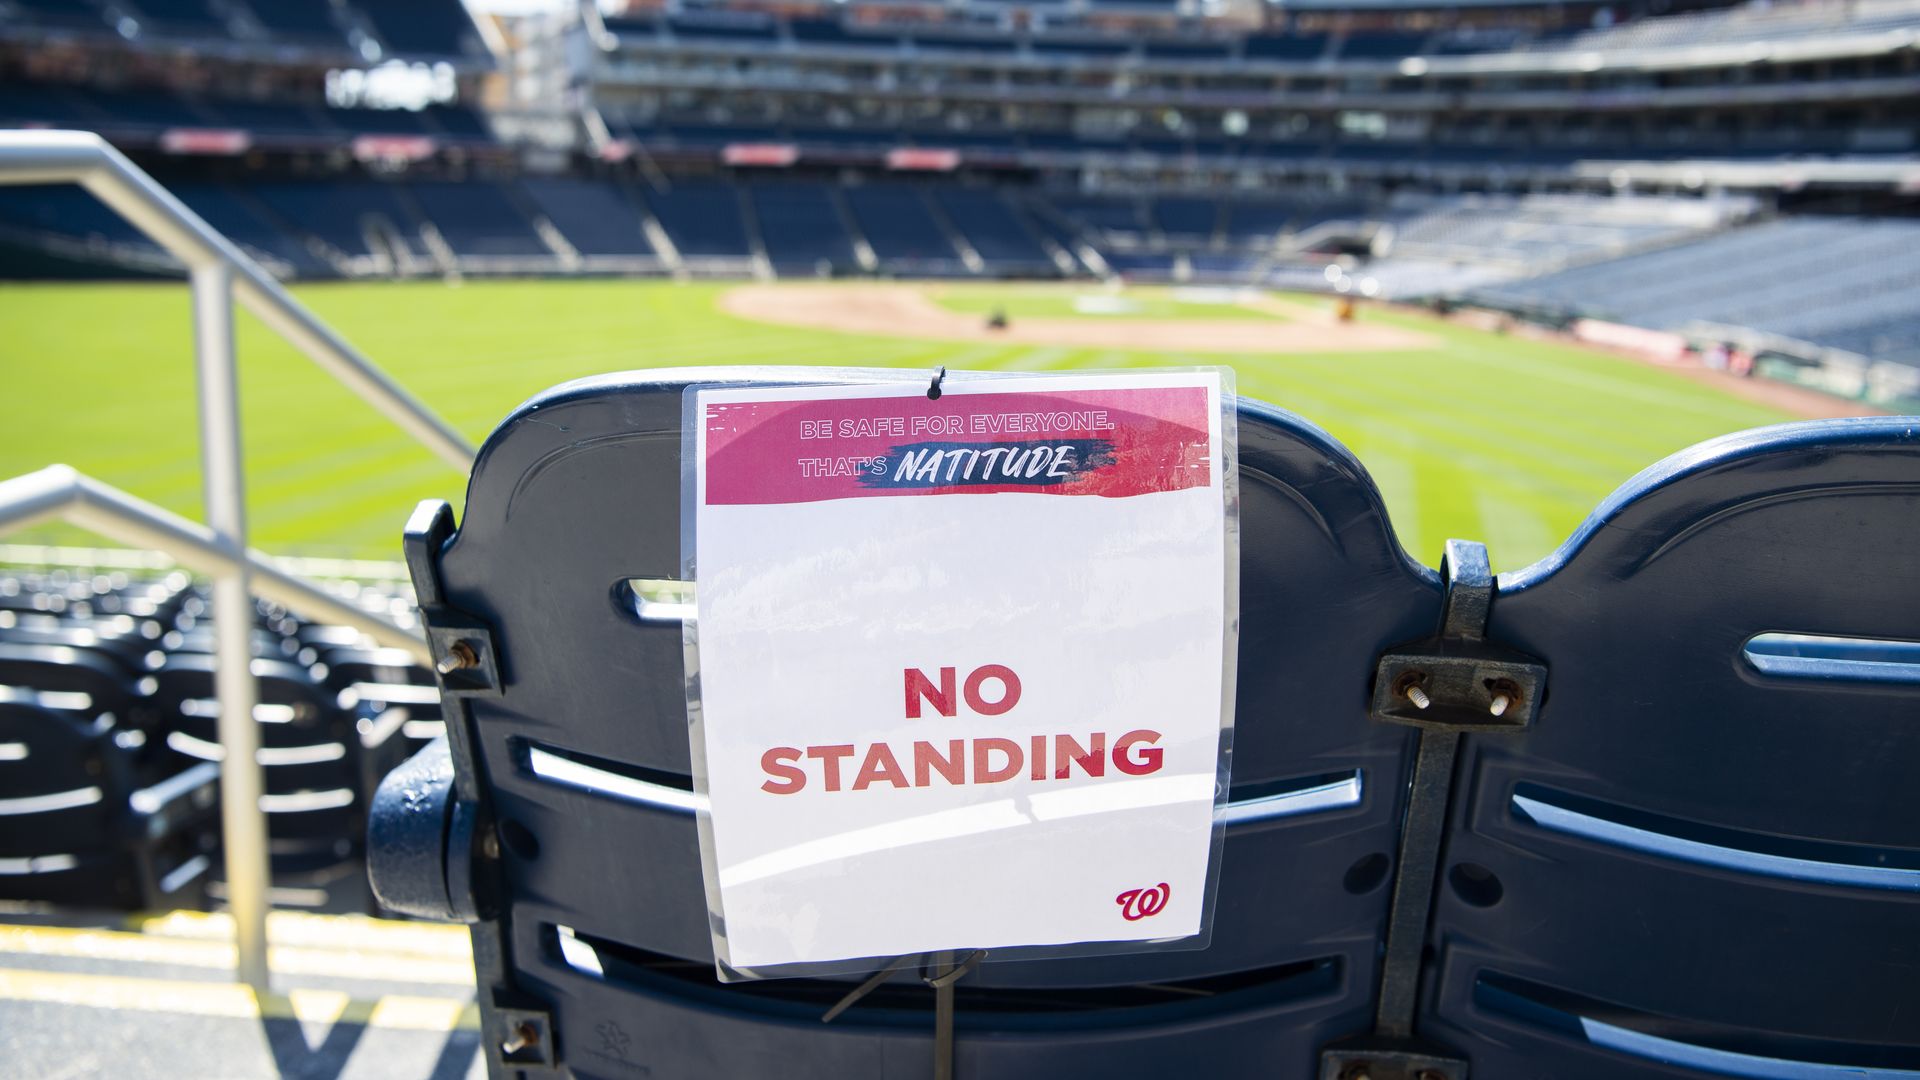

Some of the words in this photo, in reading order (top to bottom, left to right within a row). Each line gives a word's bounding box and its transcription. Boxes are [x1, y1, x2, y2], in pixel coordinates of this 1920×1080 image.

[800, 418, 832, 440] BE
[838, 416, 905, 438] SAFE
[911, 414, 964, 435] FOR
[970, 410, 1115, 434] EVERYONE.
[893, 445, 1075, 483] NATITUDE
[904, 664, 1022, 719] NO
[760, 729, 1164, 795] STANDING
